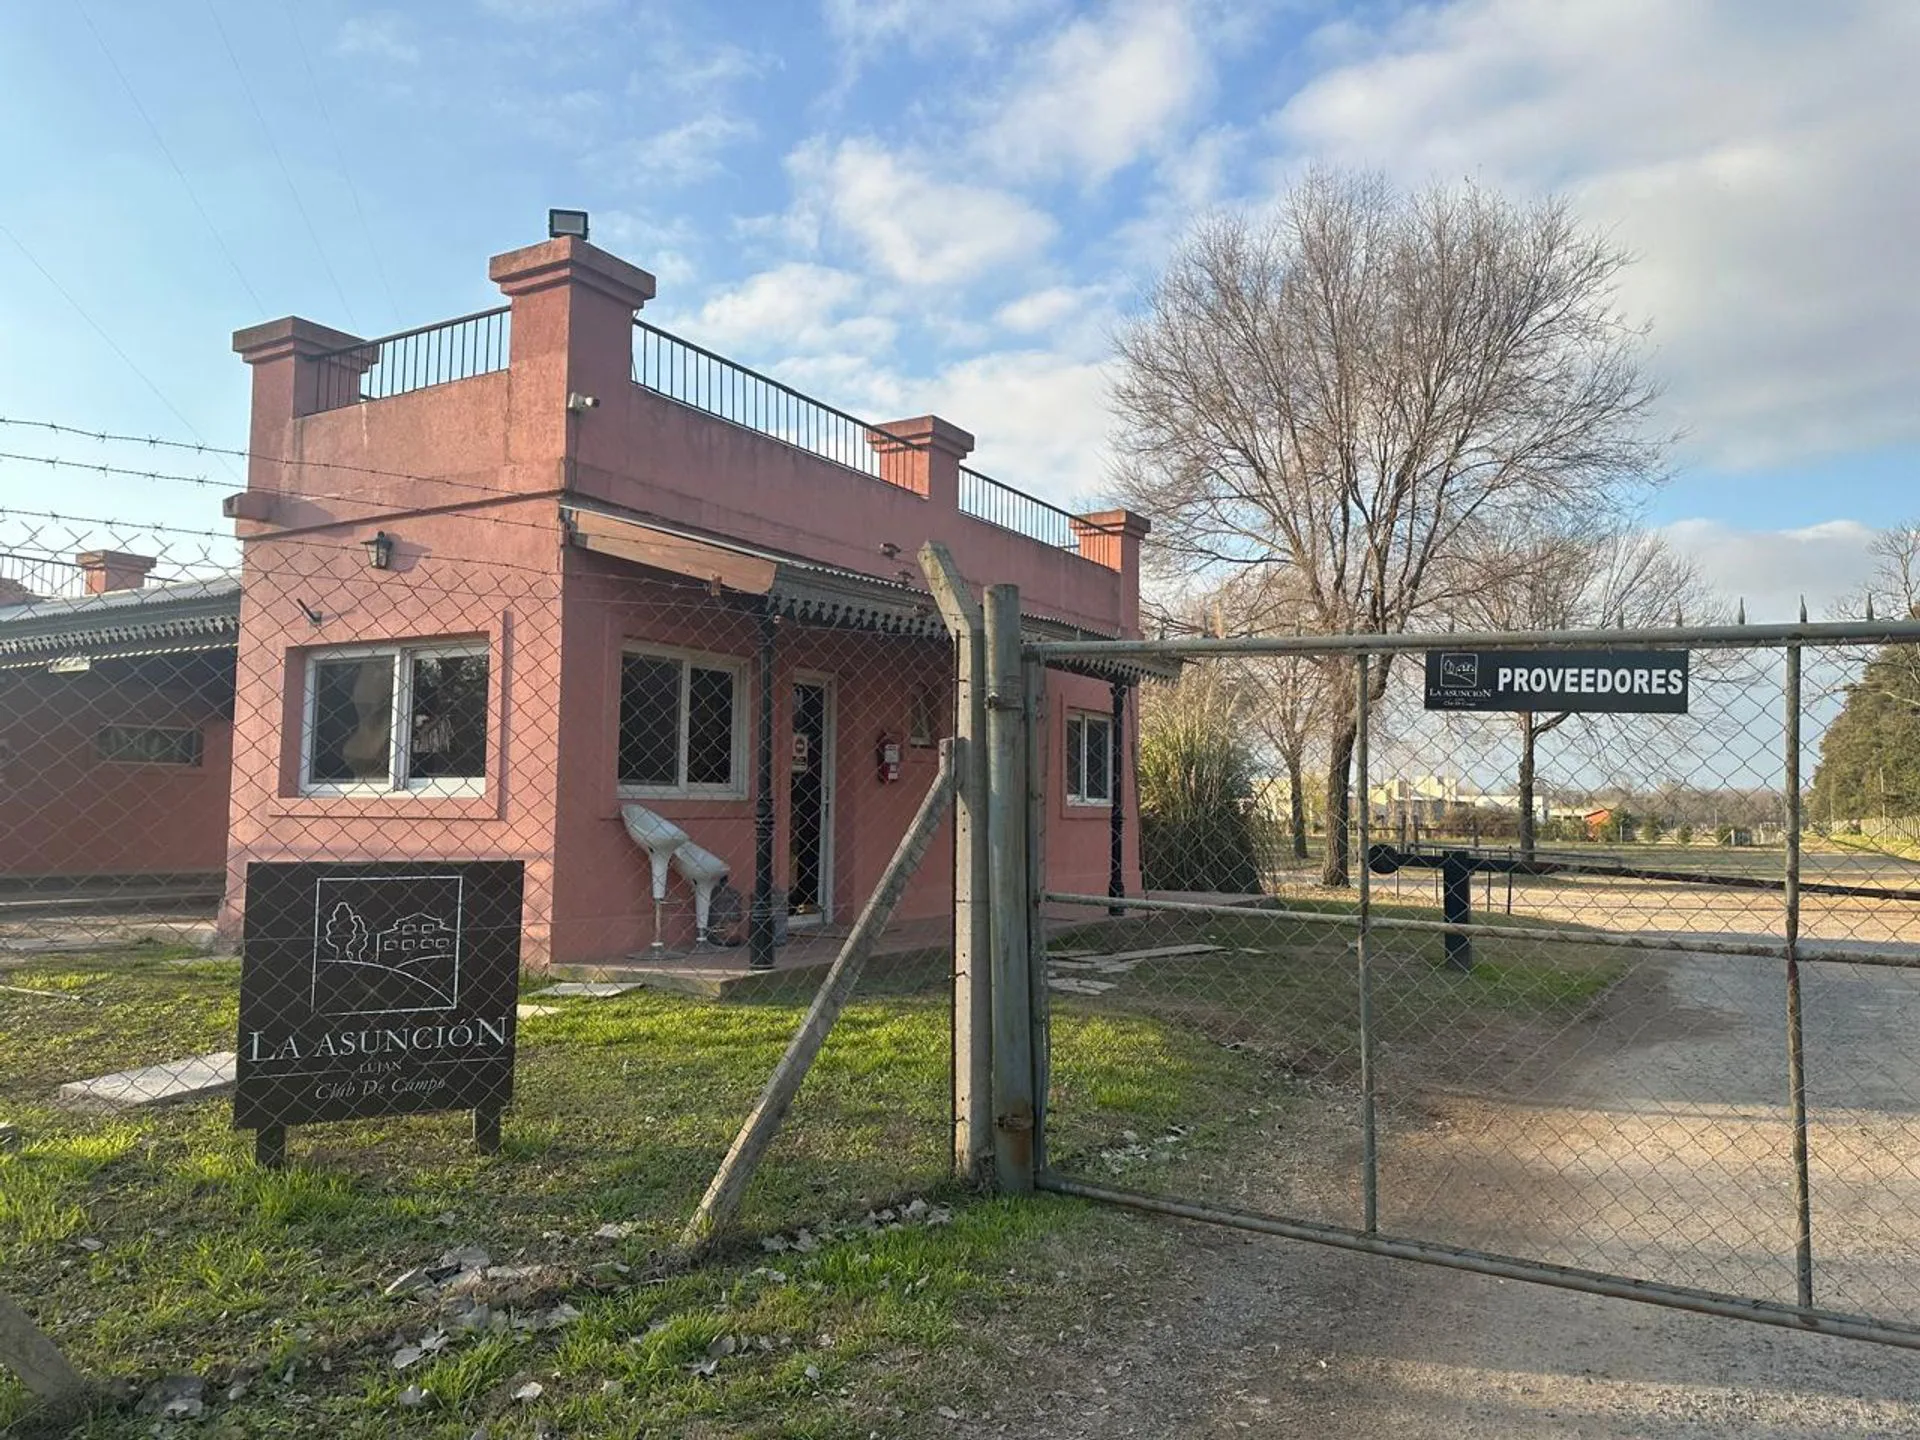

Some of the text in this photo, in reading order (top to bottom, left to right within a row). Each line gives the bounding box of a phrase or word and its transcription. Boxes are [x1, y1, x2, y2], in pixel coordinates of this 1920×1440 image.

[1497, 667, 1684, 695] PROVEEDORES
[249, 1016, 508, 1062] LA ASUNCIÓN
[314, 1077, 446, 1100] Club De Campo
